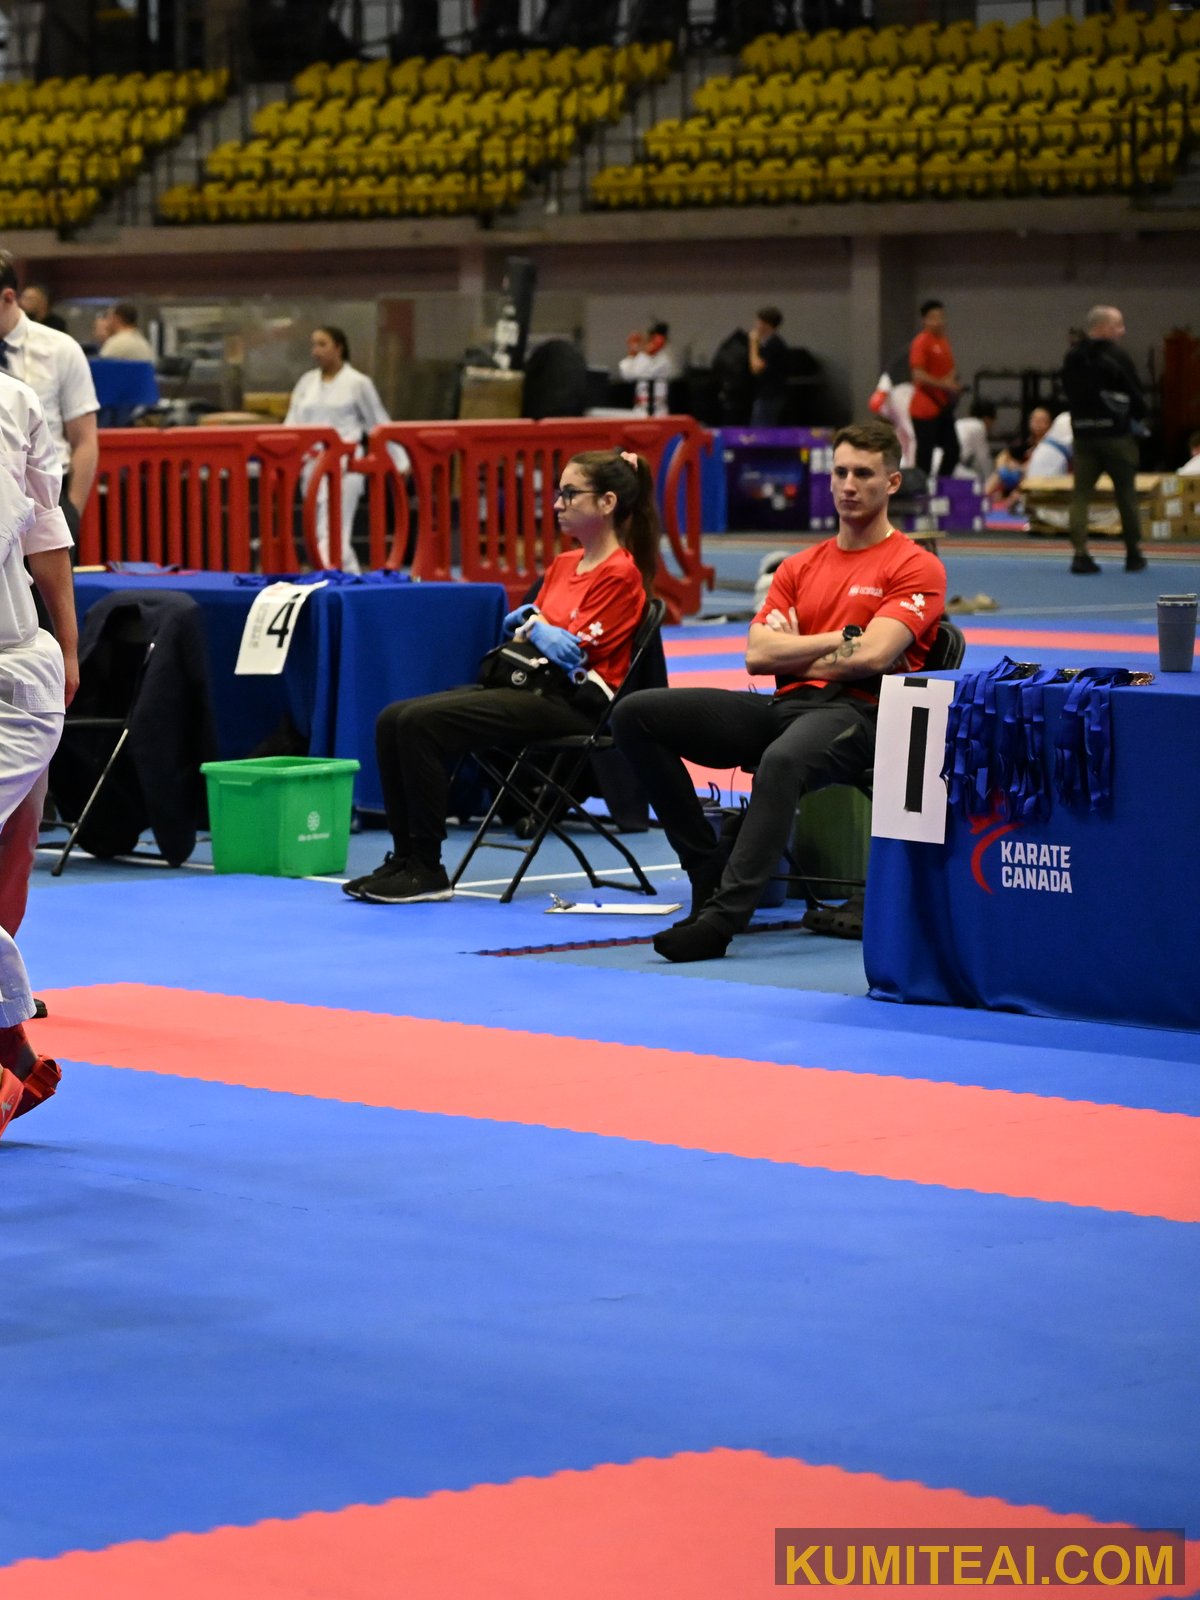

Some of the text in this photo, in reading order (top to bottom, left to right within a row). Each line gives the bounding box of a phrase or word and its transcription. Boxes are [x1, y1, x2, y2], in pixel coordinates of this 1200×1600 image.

[266, 592, 301, 648] 4
[1000, 840, 1071, 868] KARATE
[1001, 866, 1073, 893] CANADA
